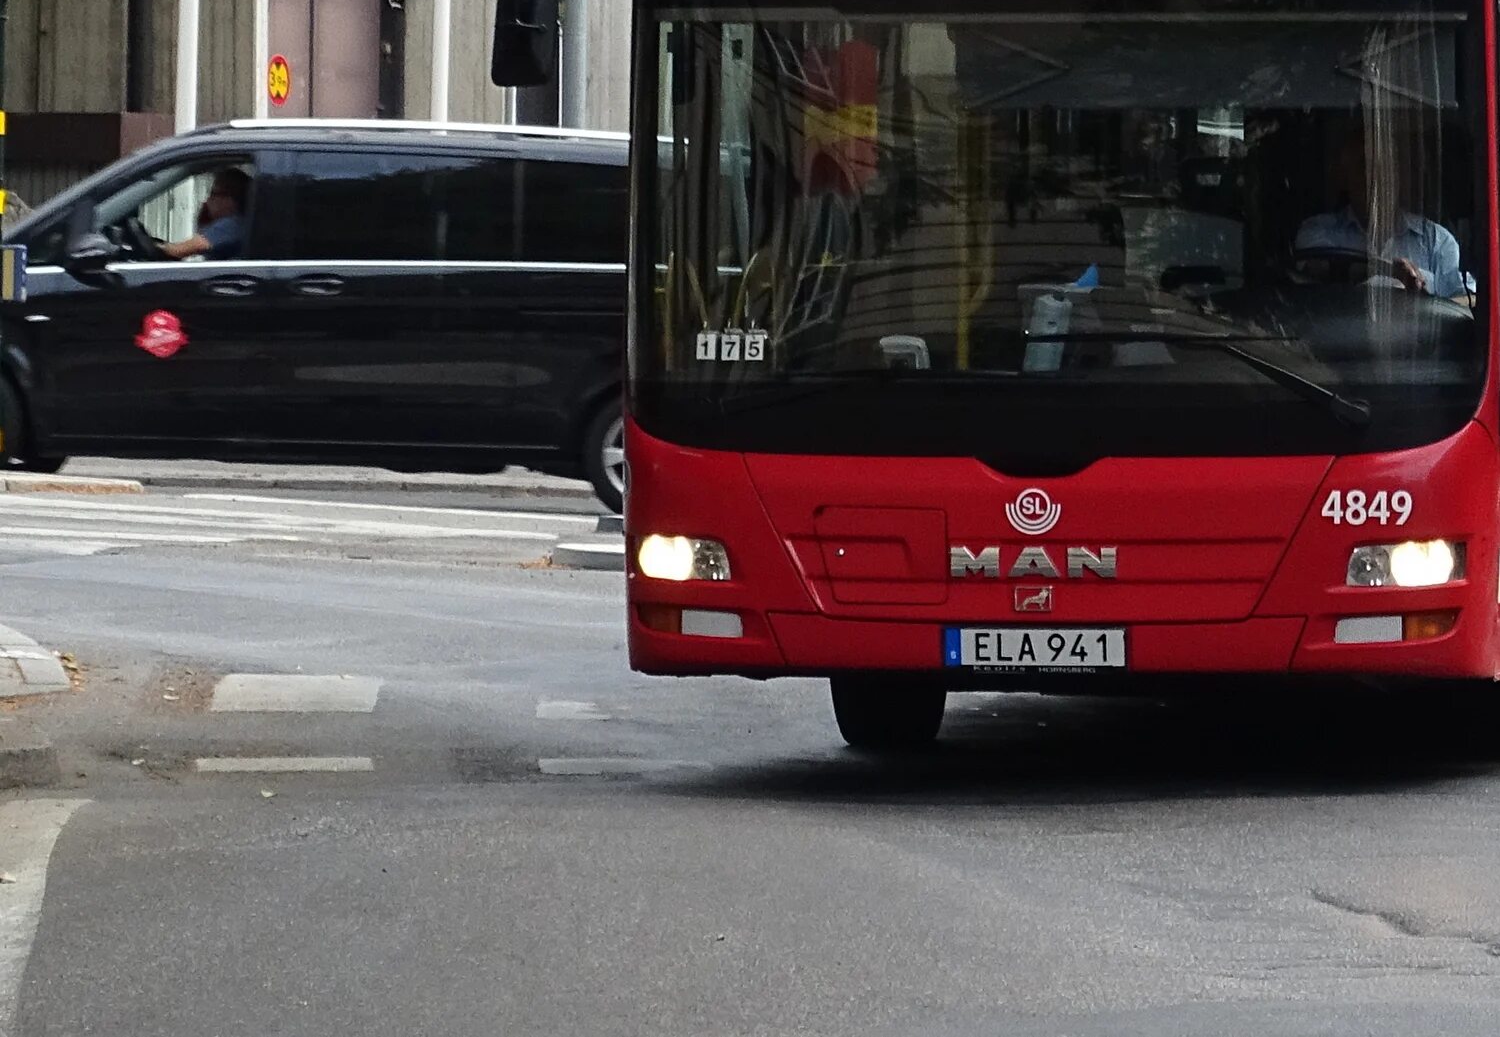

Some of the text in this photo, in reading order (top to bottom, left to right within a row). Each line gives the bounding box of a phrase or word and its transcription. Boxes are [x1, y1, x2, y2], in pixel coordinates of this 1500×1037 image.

[701, 341, 760, 357] 175
[1022, 497, 1044, 514] SL
[1321, 490, 1412, 525] 4849
[951, 546, 1117, 578] MAN
[975, 633, 1107, 662] ELA 941
